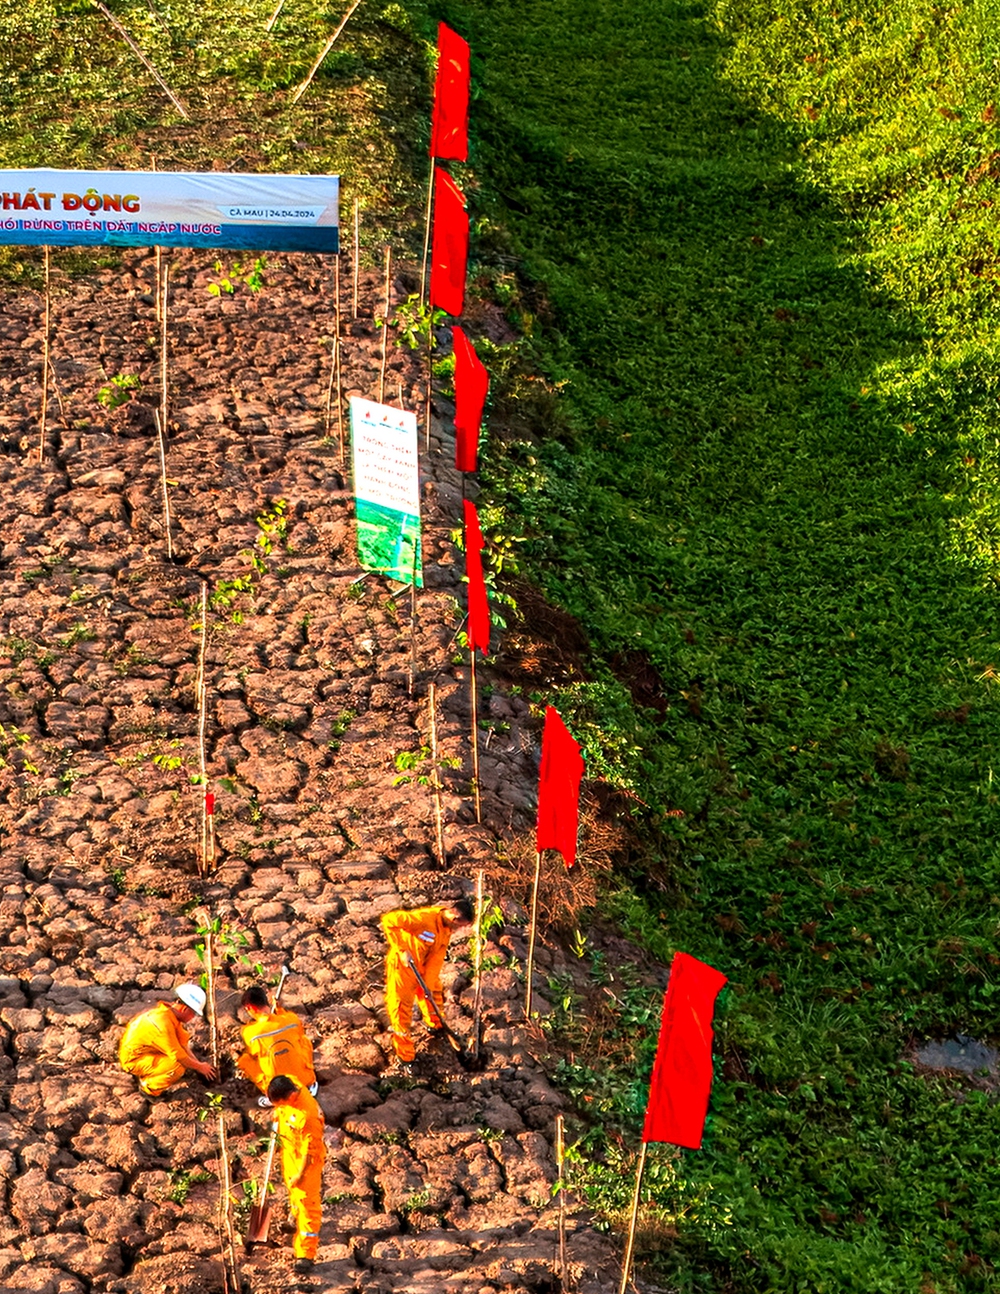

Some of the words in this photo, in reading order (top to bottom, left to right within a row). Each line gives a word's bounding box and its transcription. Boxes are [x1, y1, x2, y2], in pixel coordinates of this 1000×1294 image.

[61, 187, 141, 216] ĐỘNG
[243, 209, 264, 217] MAU
[66, 219, 102, 231] TRÊN
